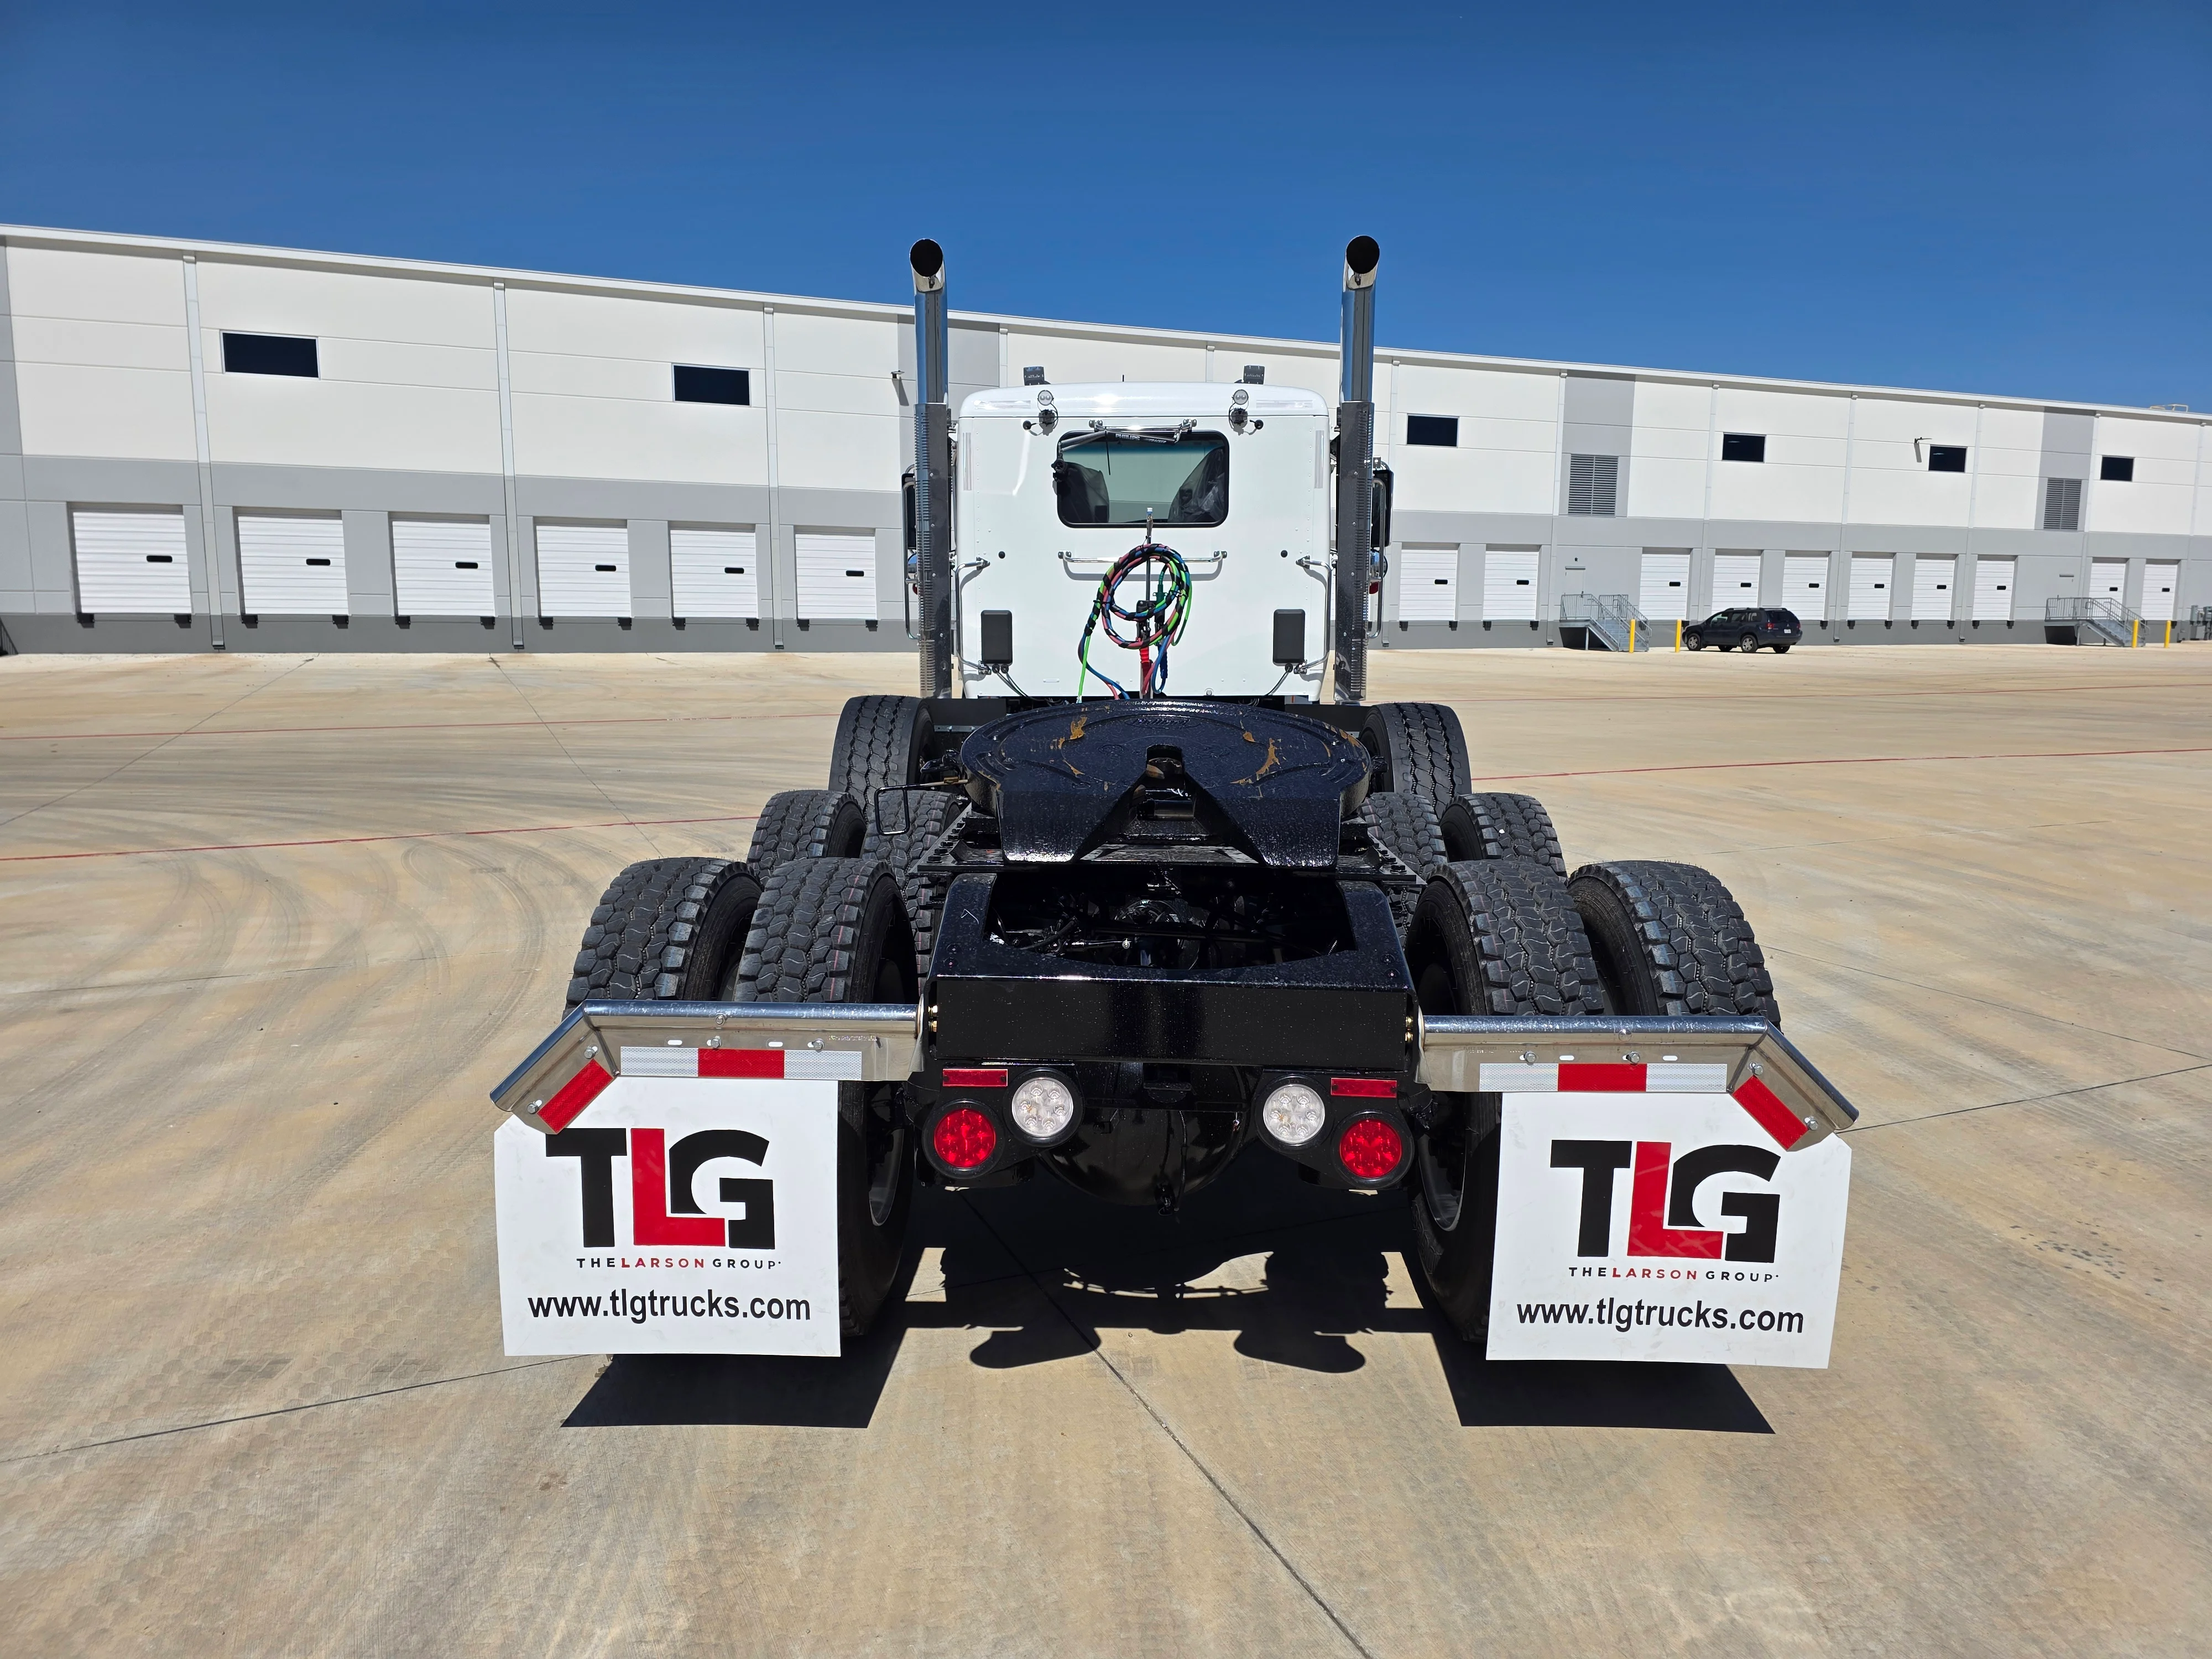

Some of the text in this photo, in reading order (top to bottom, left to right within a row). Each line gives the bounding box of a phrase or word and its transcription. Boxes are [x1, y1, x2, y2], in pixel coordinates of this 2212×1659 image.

[545, 1128, 775, 1250] TLG
[1550, 1140, 1781, 1264] TLG
[527, 1288, 811, 1324] www.tlgtrucks.com
[1516, 1297, 1804, 1333] www.tlgtrucks.com
